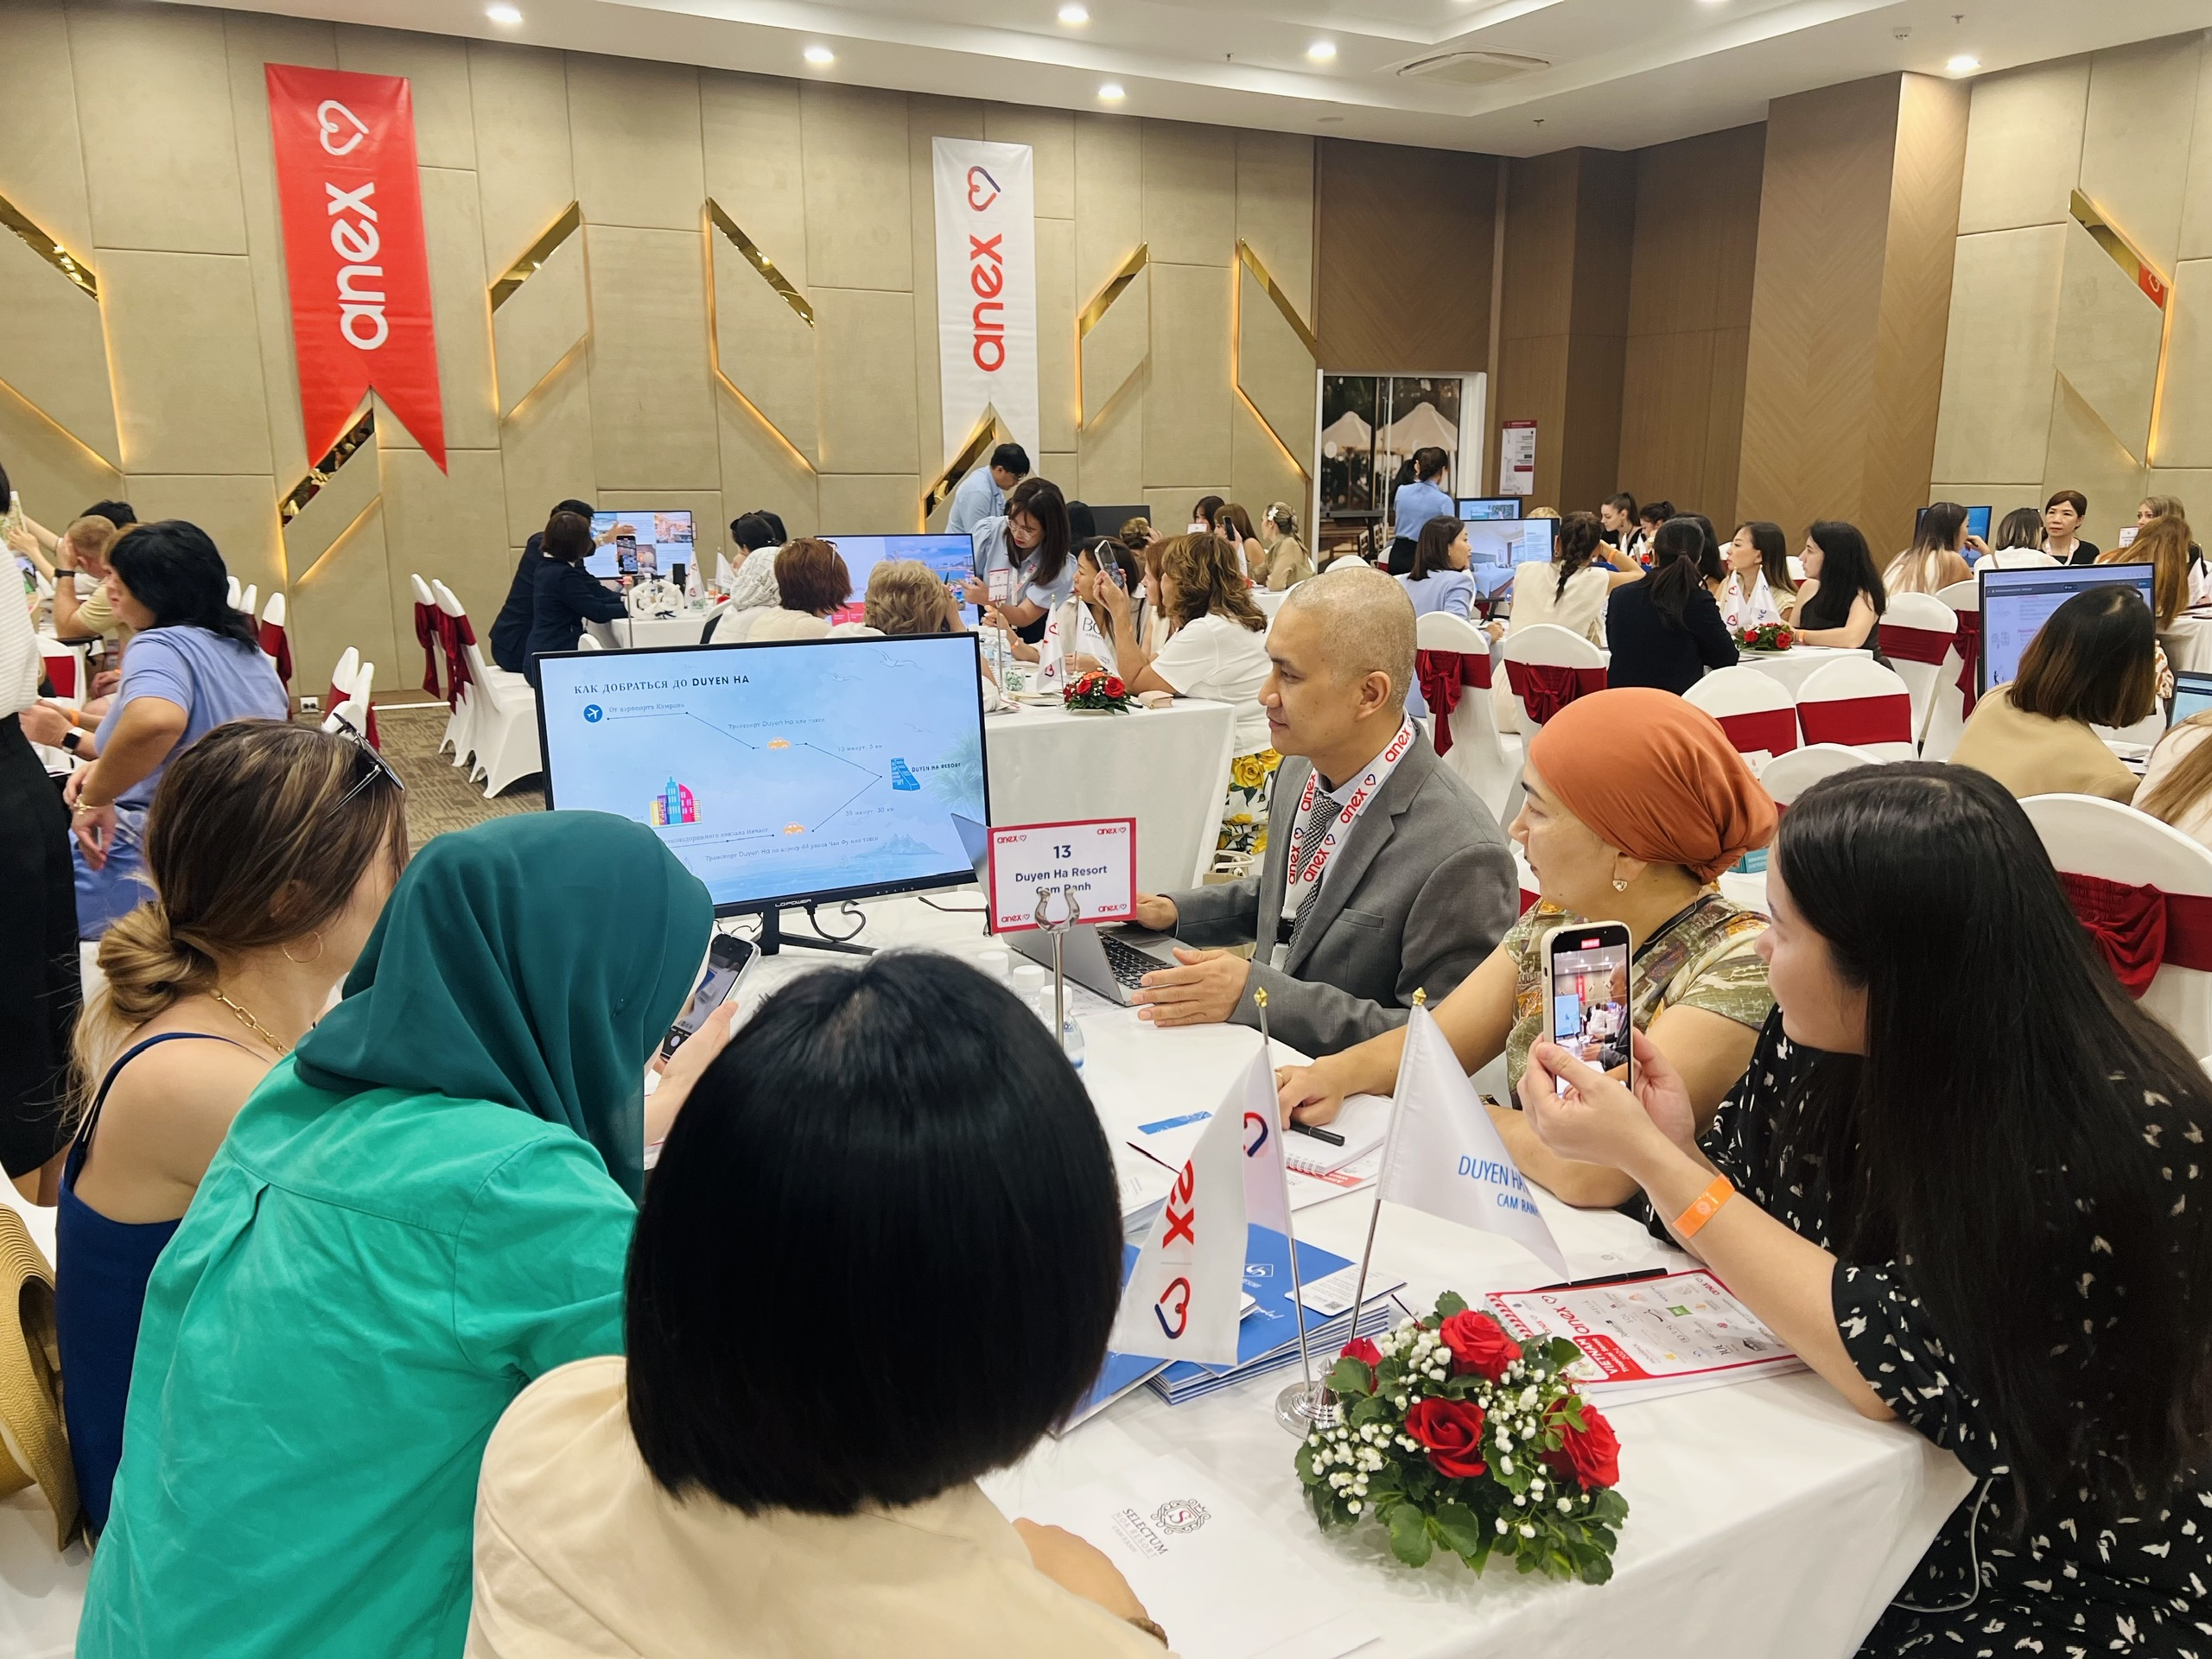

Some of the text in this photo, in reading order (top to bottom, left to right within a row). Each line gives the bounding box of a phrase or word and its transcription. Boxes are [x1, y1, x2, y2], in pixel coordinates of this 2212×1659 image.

[325, 181, 389, 350] anex
[969, 233, 1005, 372] anex
[574, 675, 750, 694] КАК ДОБРАТЬСЯ ДО DUYEN HA
[762, 720, 784, 728] Duyen
[1385, 728, 1411, 762] anex
[1300, 773, 1316, 811] anex
[1340, 788, 1368, 823] anex
[664, 833, 720, 844] лезнодорожного
[997, 835, 1018, 843] anex
[1053, 845, 1071, 859] 13
[1015, 866, 1107, 882] Duyen Ha Resort
[1288, 845, 1301, 885] anex
[1303, 848, 1330, 882] anex
[1001, 914, 1021, 923] anex
[1458, 1155, 1509, 1186] DUYEN
[1162, 1160, 1193, 1249] ex
[1497, 1193, 1518, 1210] CAM
[1554, 1306, 1590, 1334] anex
[1576, 1338, 1619, 1375] VIETNAM
[1605, 1352, 1630, 1373] Tropical
[1122, 1508, 1168, 1555] SELECTUM
[1130, 1529, 1159, 1558] RESORT
